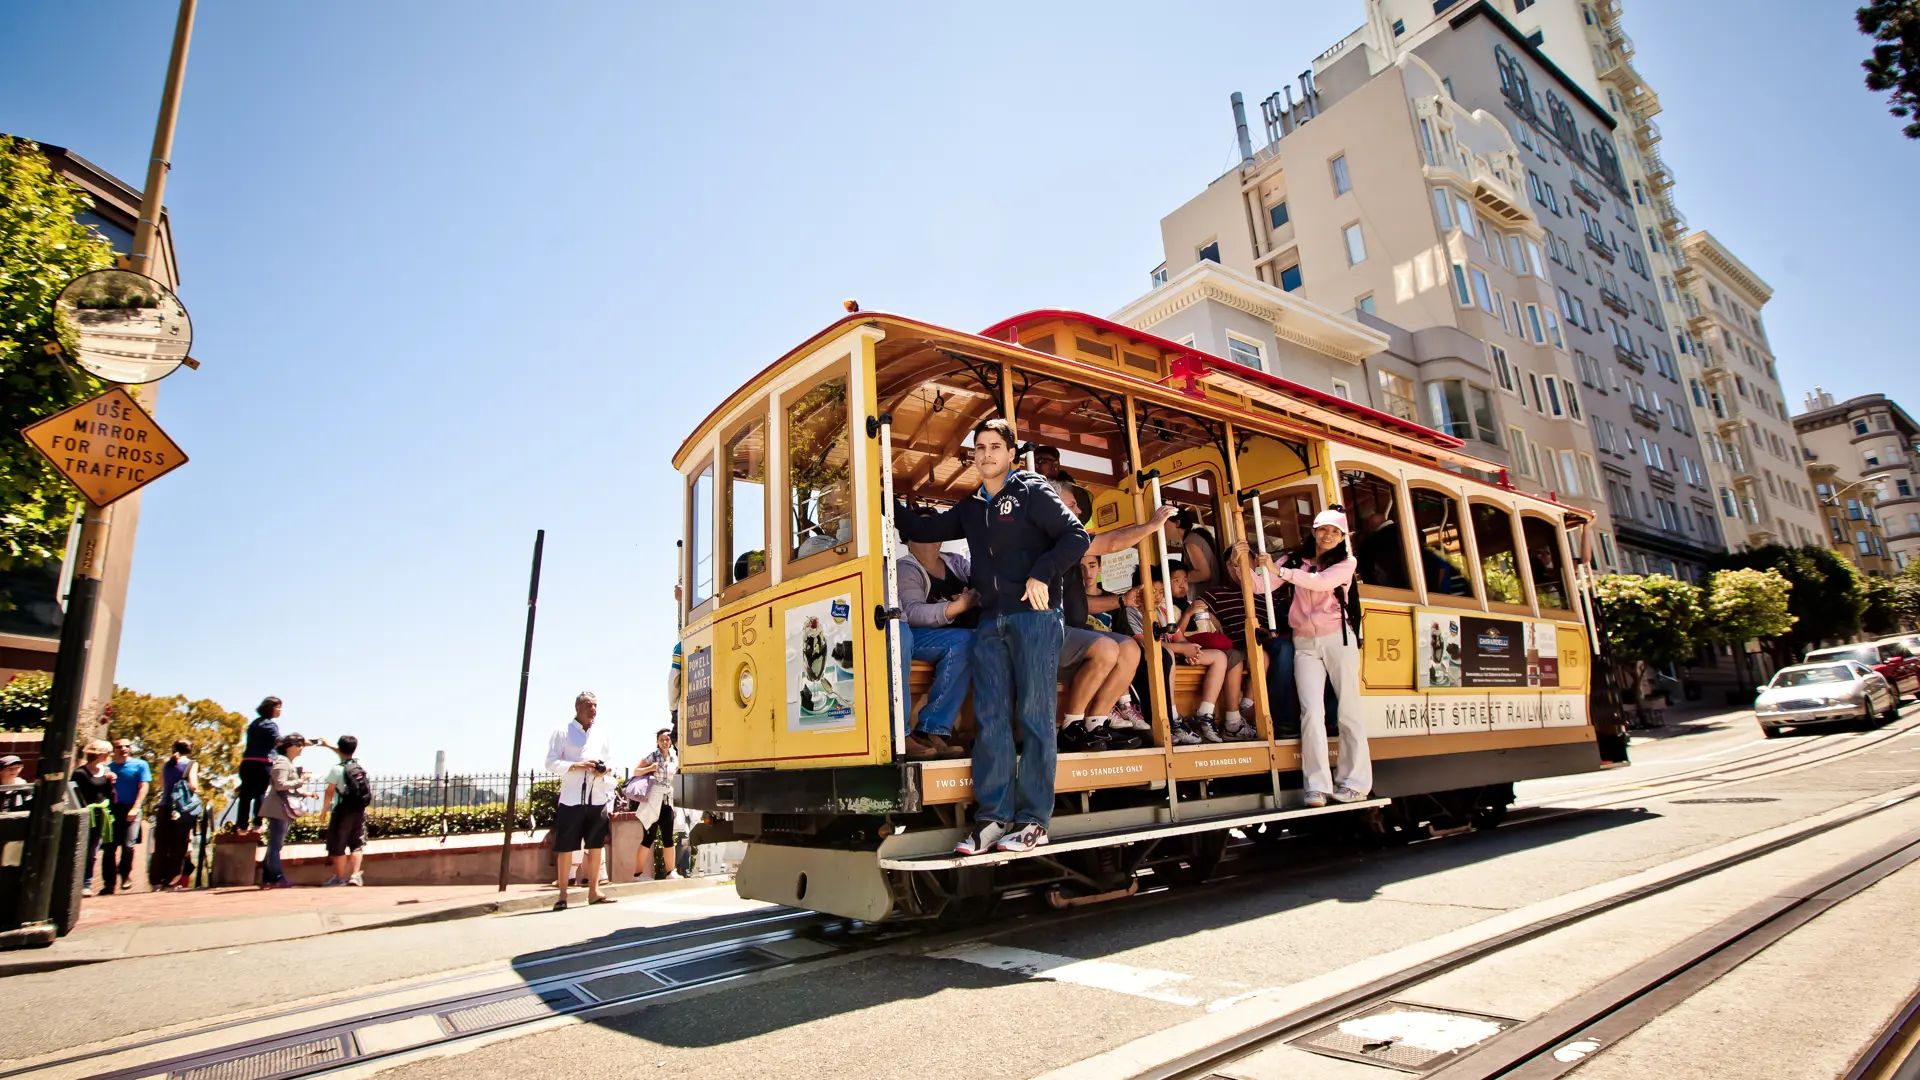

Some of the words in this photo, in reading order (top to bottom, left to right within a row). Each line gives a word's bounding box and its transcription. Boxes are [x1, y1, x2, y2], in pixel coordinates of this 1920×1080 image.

[96, 402, 133, 421] USE
[74, 418, 148, 443] MIRROR
[51, 435, 90, 454] FOR
[104, 444, 165, 466] CROSS
[65, 457, 145, 482] TRAFFIC
[1172, 460, 1183, 470] 15
[1000, 500, 1012, 515] 19
[731, 614, 757, 650] 15
[1377, 637, 1401, 662] 15
[1562, 649, 1578, 668] 15
[689, 654, 710, 672] POWELL
[694, 668, 704, 679] AND
[688, 676, 710, 693] MARKET
[1386, 703, 1446, 730] MARKET
[1452, 702, 1501, 727] STREET
[1507, 701, 1553, 724] RAILWAY
[1071, 769, 1088, 778] TWO
[1090, 767, 1125, 776] STANDEES
[1126, 765, 1143, 773] ONLY
[1209, 758, 1237, 767] STANDEES
[935, 780, 956, 788] TWO
